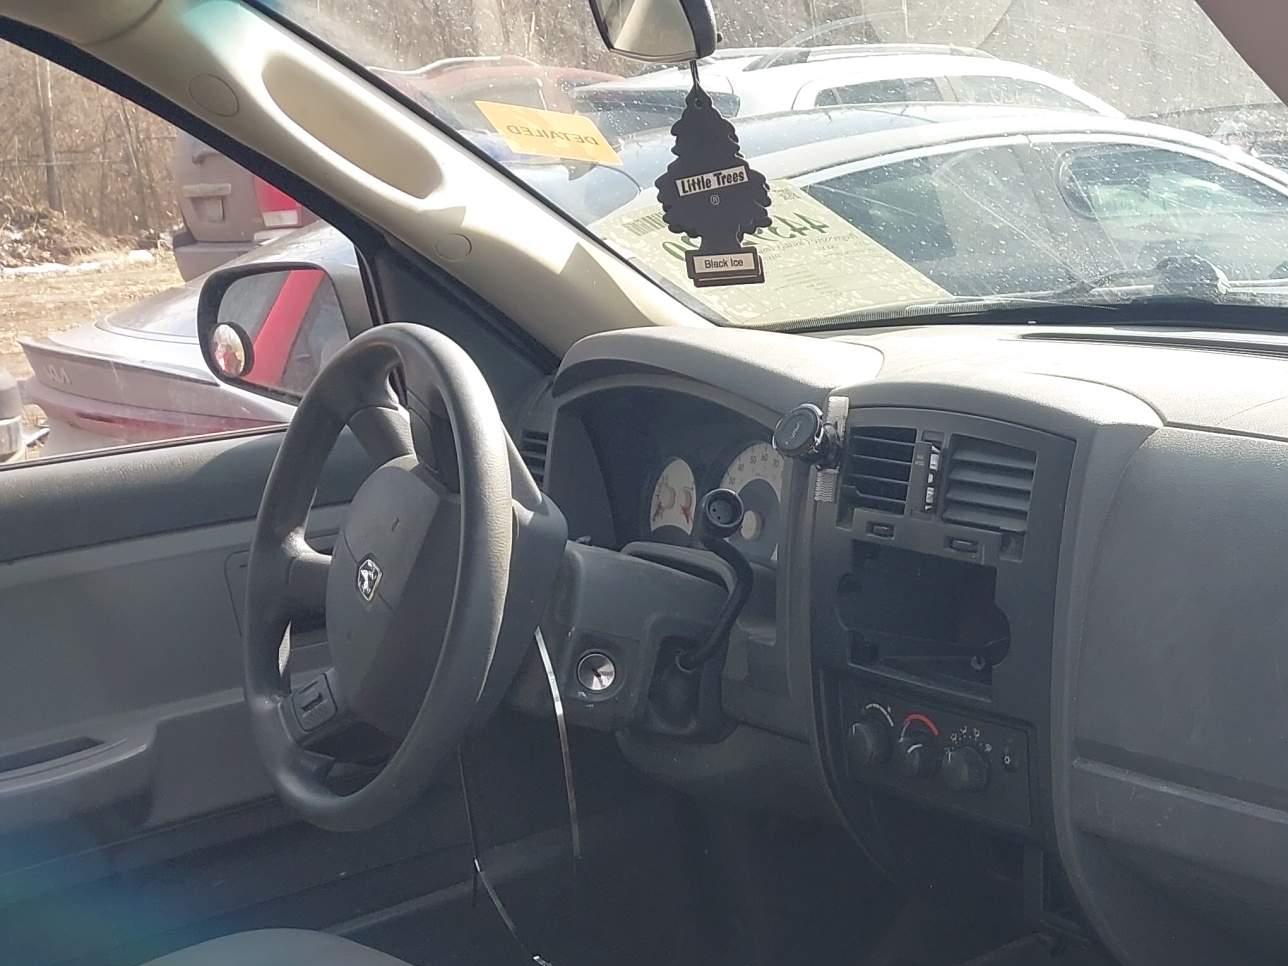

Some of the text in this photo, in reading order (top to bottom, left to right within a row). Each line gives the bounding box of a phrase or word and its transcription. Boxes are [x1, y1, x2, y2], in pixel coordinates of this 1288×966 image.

[680, 170, 745, 194] Little Trees
[704, 257, 744, 269] Black Ice
